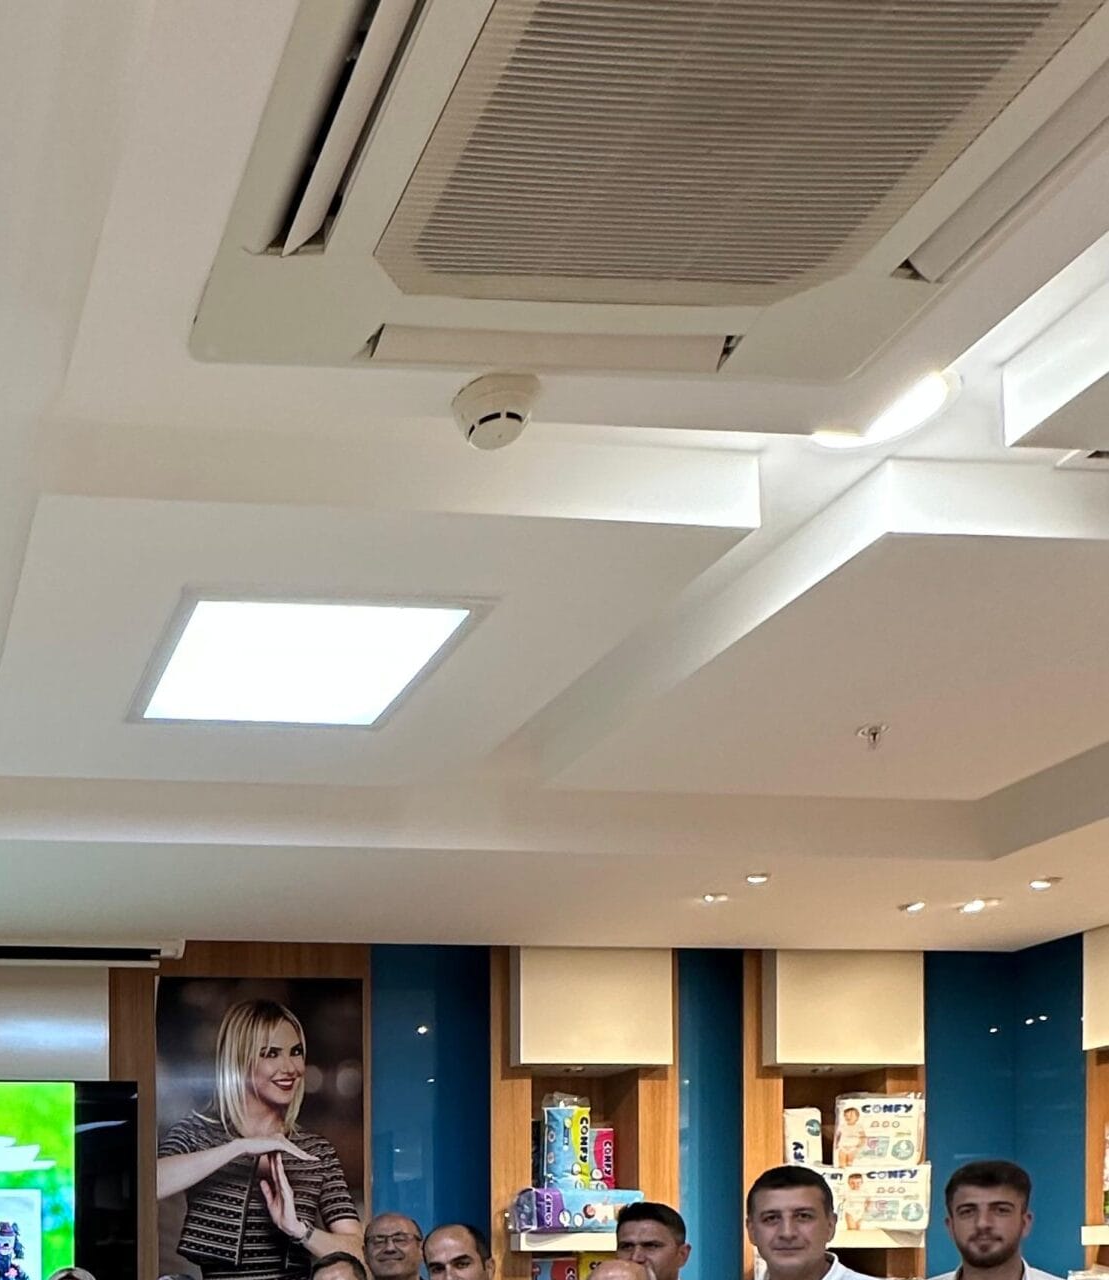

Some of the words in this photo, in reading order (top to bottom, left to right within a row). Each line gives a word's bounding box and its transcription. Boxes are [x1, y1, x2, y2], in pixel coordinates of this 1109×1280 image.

[860, 1104, 914, 1114] CONFY
[578, 1115, 590, 1163] CONFY
[603, 1140, 613, 1176] CONFY
[866, 1169, 919, 1180] CONFY
